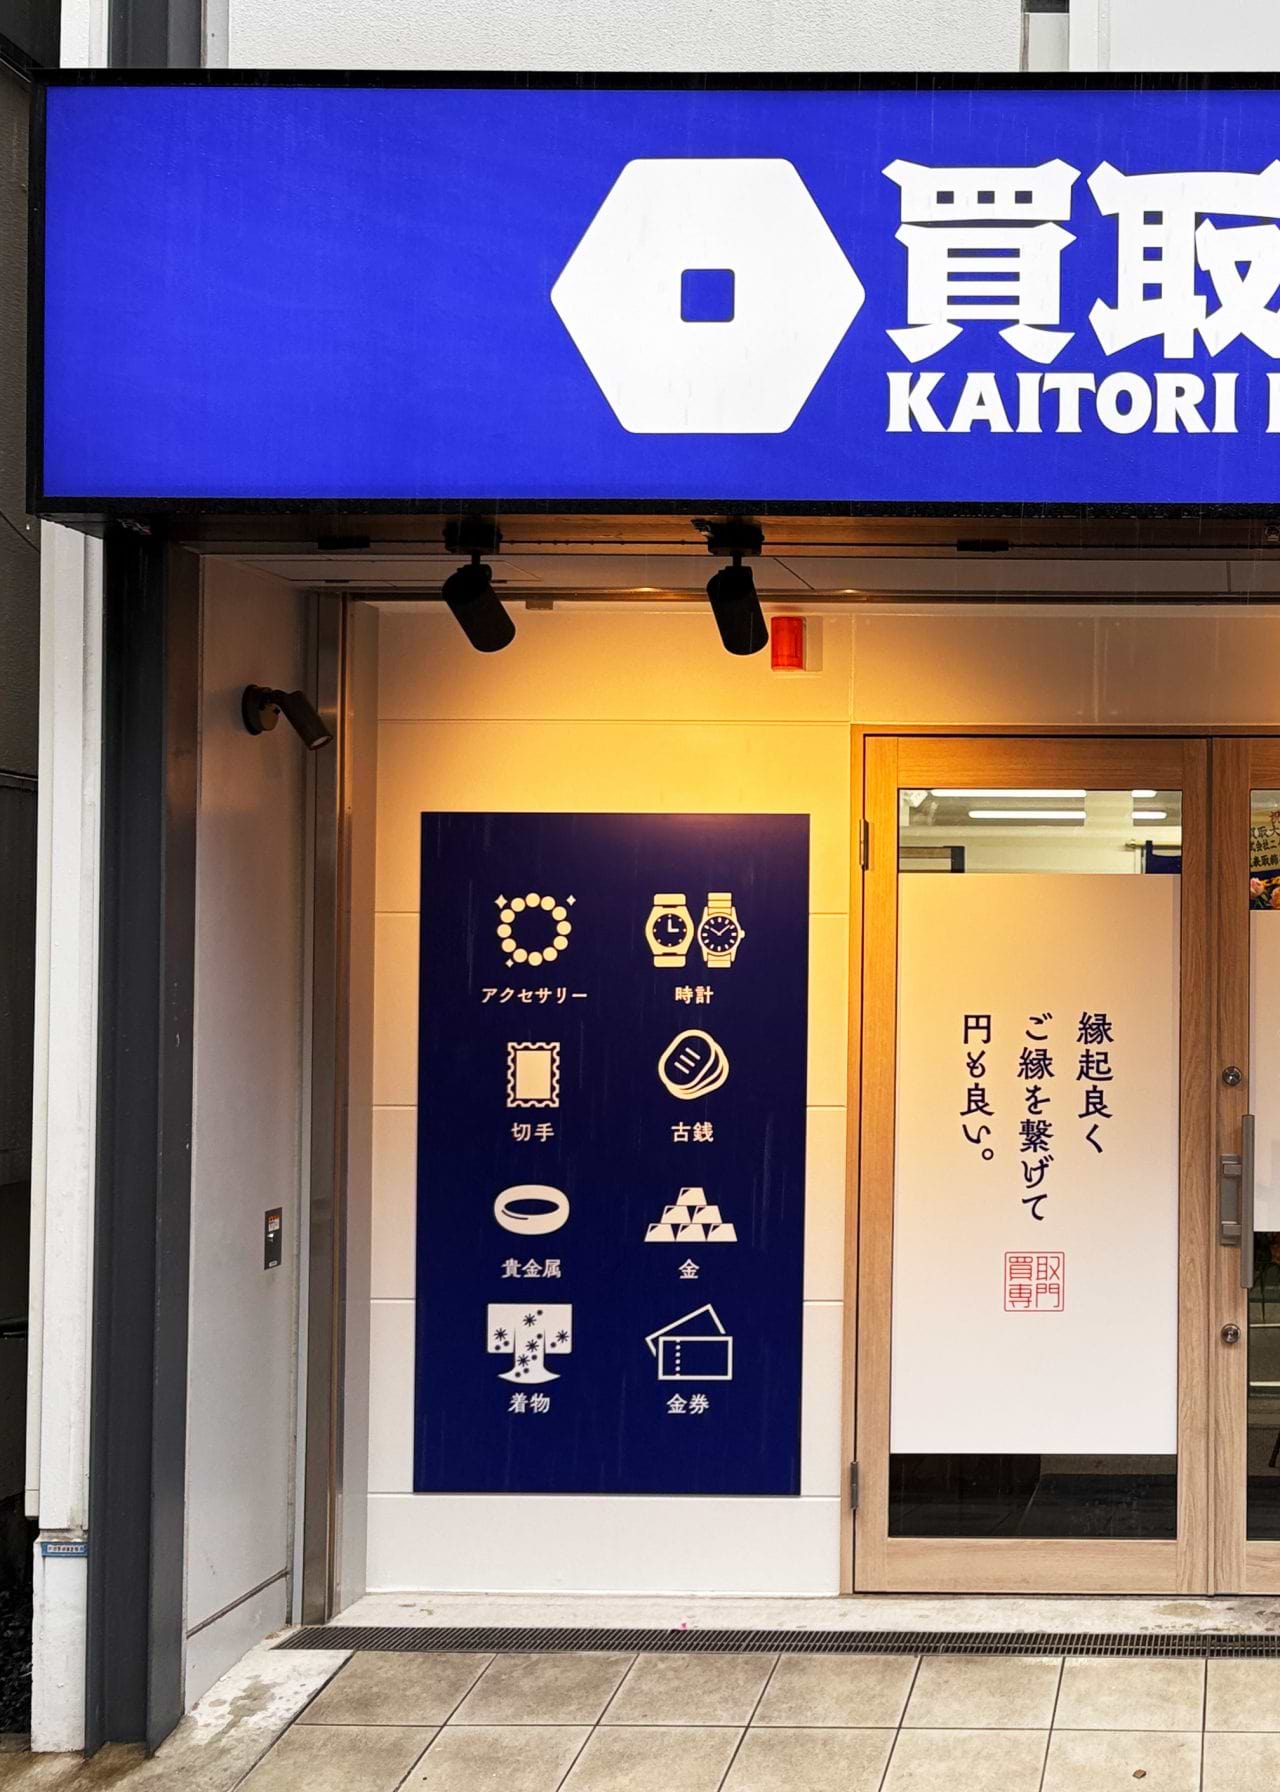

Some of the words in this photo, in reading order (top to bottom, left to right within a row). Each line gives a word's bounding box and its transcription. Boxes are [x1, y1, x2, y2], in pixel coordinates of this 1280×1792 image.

[886, 372, 1239, 434] KAITORI
[481, 987, 588, 1004] アクセサリー
[674, 986, 714, 1005] 時計
[959, 1014, 995, 1161] 円も良い。
[1076, 1012, 1115, 1154] 縁起良く
[1017, 1012, 1055, 1221] ご縁を繋げて
[511, 1122, 555, 1142] 切手
[671, 1121, 714, 1142] 古銭
[501, 1258, 562, 1279] 貴金属
[679, 1258, 700, 1279] 金
[1008, 1256, 1061, 1281] 買取
[508, 1393, 551, 1414] 着物
[666, 1394, 710, 1415] 金券
